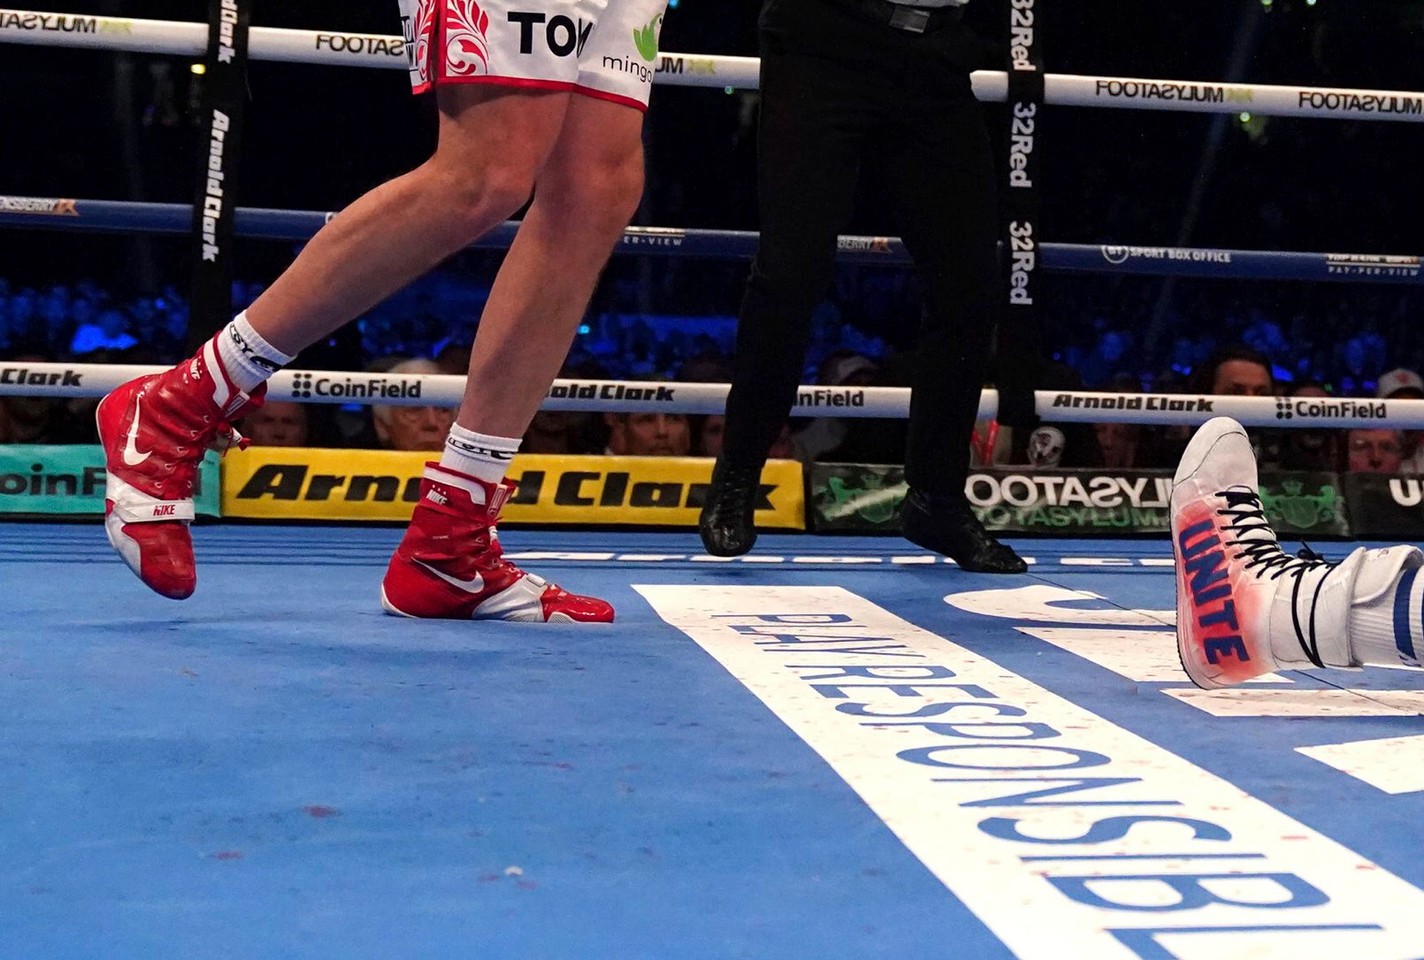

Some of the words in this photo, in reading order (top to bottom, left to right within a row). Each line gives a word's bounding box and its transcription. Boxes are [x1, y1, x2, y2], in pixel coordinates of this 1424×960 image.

[315, 33, 404, 58] FOOTAS
[1096, 79, 1224, 103] FOOTASYLUM
[1299, 91, 1423, 115] FOOTASYLUM
[206, 109, 230, 197] Arnold
[1010, 101, 1037, 188] 32Red
[202, 195, 223, 263] Clark
[1010, 221, 1036, 305] 32Red
[1129, 246, 1165, 258] SPORT
[1167, 248, 1191, 260] BOX
[1192, 250, 1231, 262] OFFICE
[0, 367, 82, 388] Clark
[315, 377, 421, 400] CoinField
[546, 383, 598, 400] old
[600, 385, 675, 402] Clark
[795, 389, 864, 407] nField
[1053, 393, 1142, 411] Arnold
[1145, 397, 1214, 413] Clark
[1296, 401, 1387, 419] CoinField
[236, 463, 545, 504] Arnd
[964, 474, 1173, 509] OOTASYL
[426, 489, 448, 506] NIKE
[153, 504, 176, 517] NIKE
[1178, 518, 1250, 666] UNITE
[709, 611, 925, 660] PLAY
